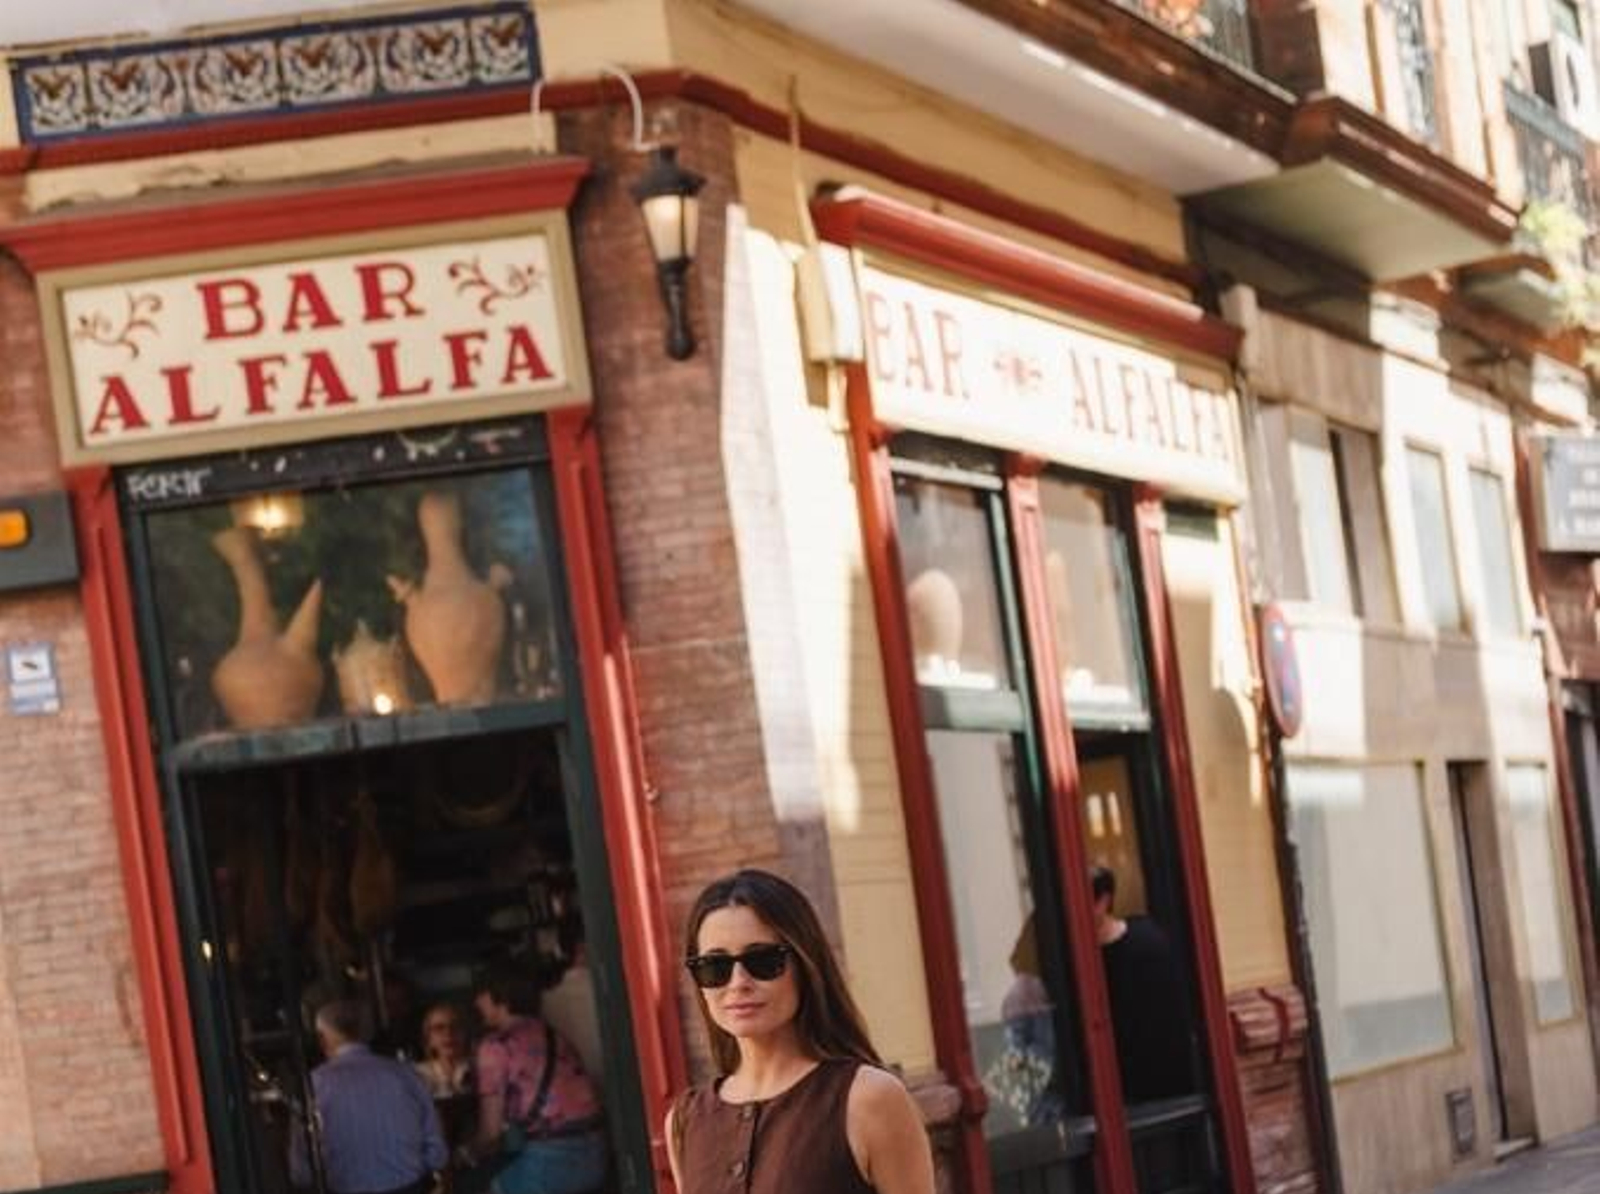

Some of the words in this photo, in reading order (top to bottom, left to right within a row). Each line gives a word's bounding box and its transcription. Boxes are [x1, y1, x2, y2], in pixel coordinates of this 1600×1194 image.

[196, 262, 425, 341] BAR
[88, 325, 554, 436] ALFALFA
[1069, 344, 1230, 461] ALFALFA
